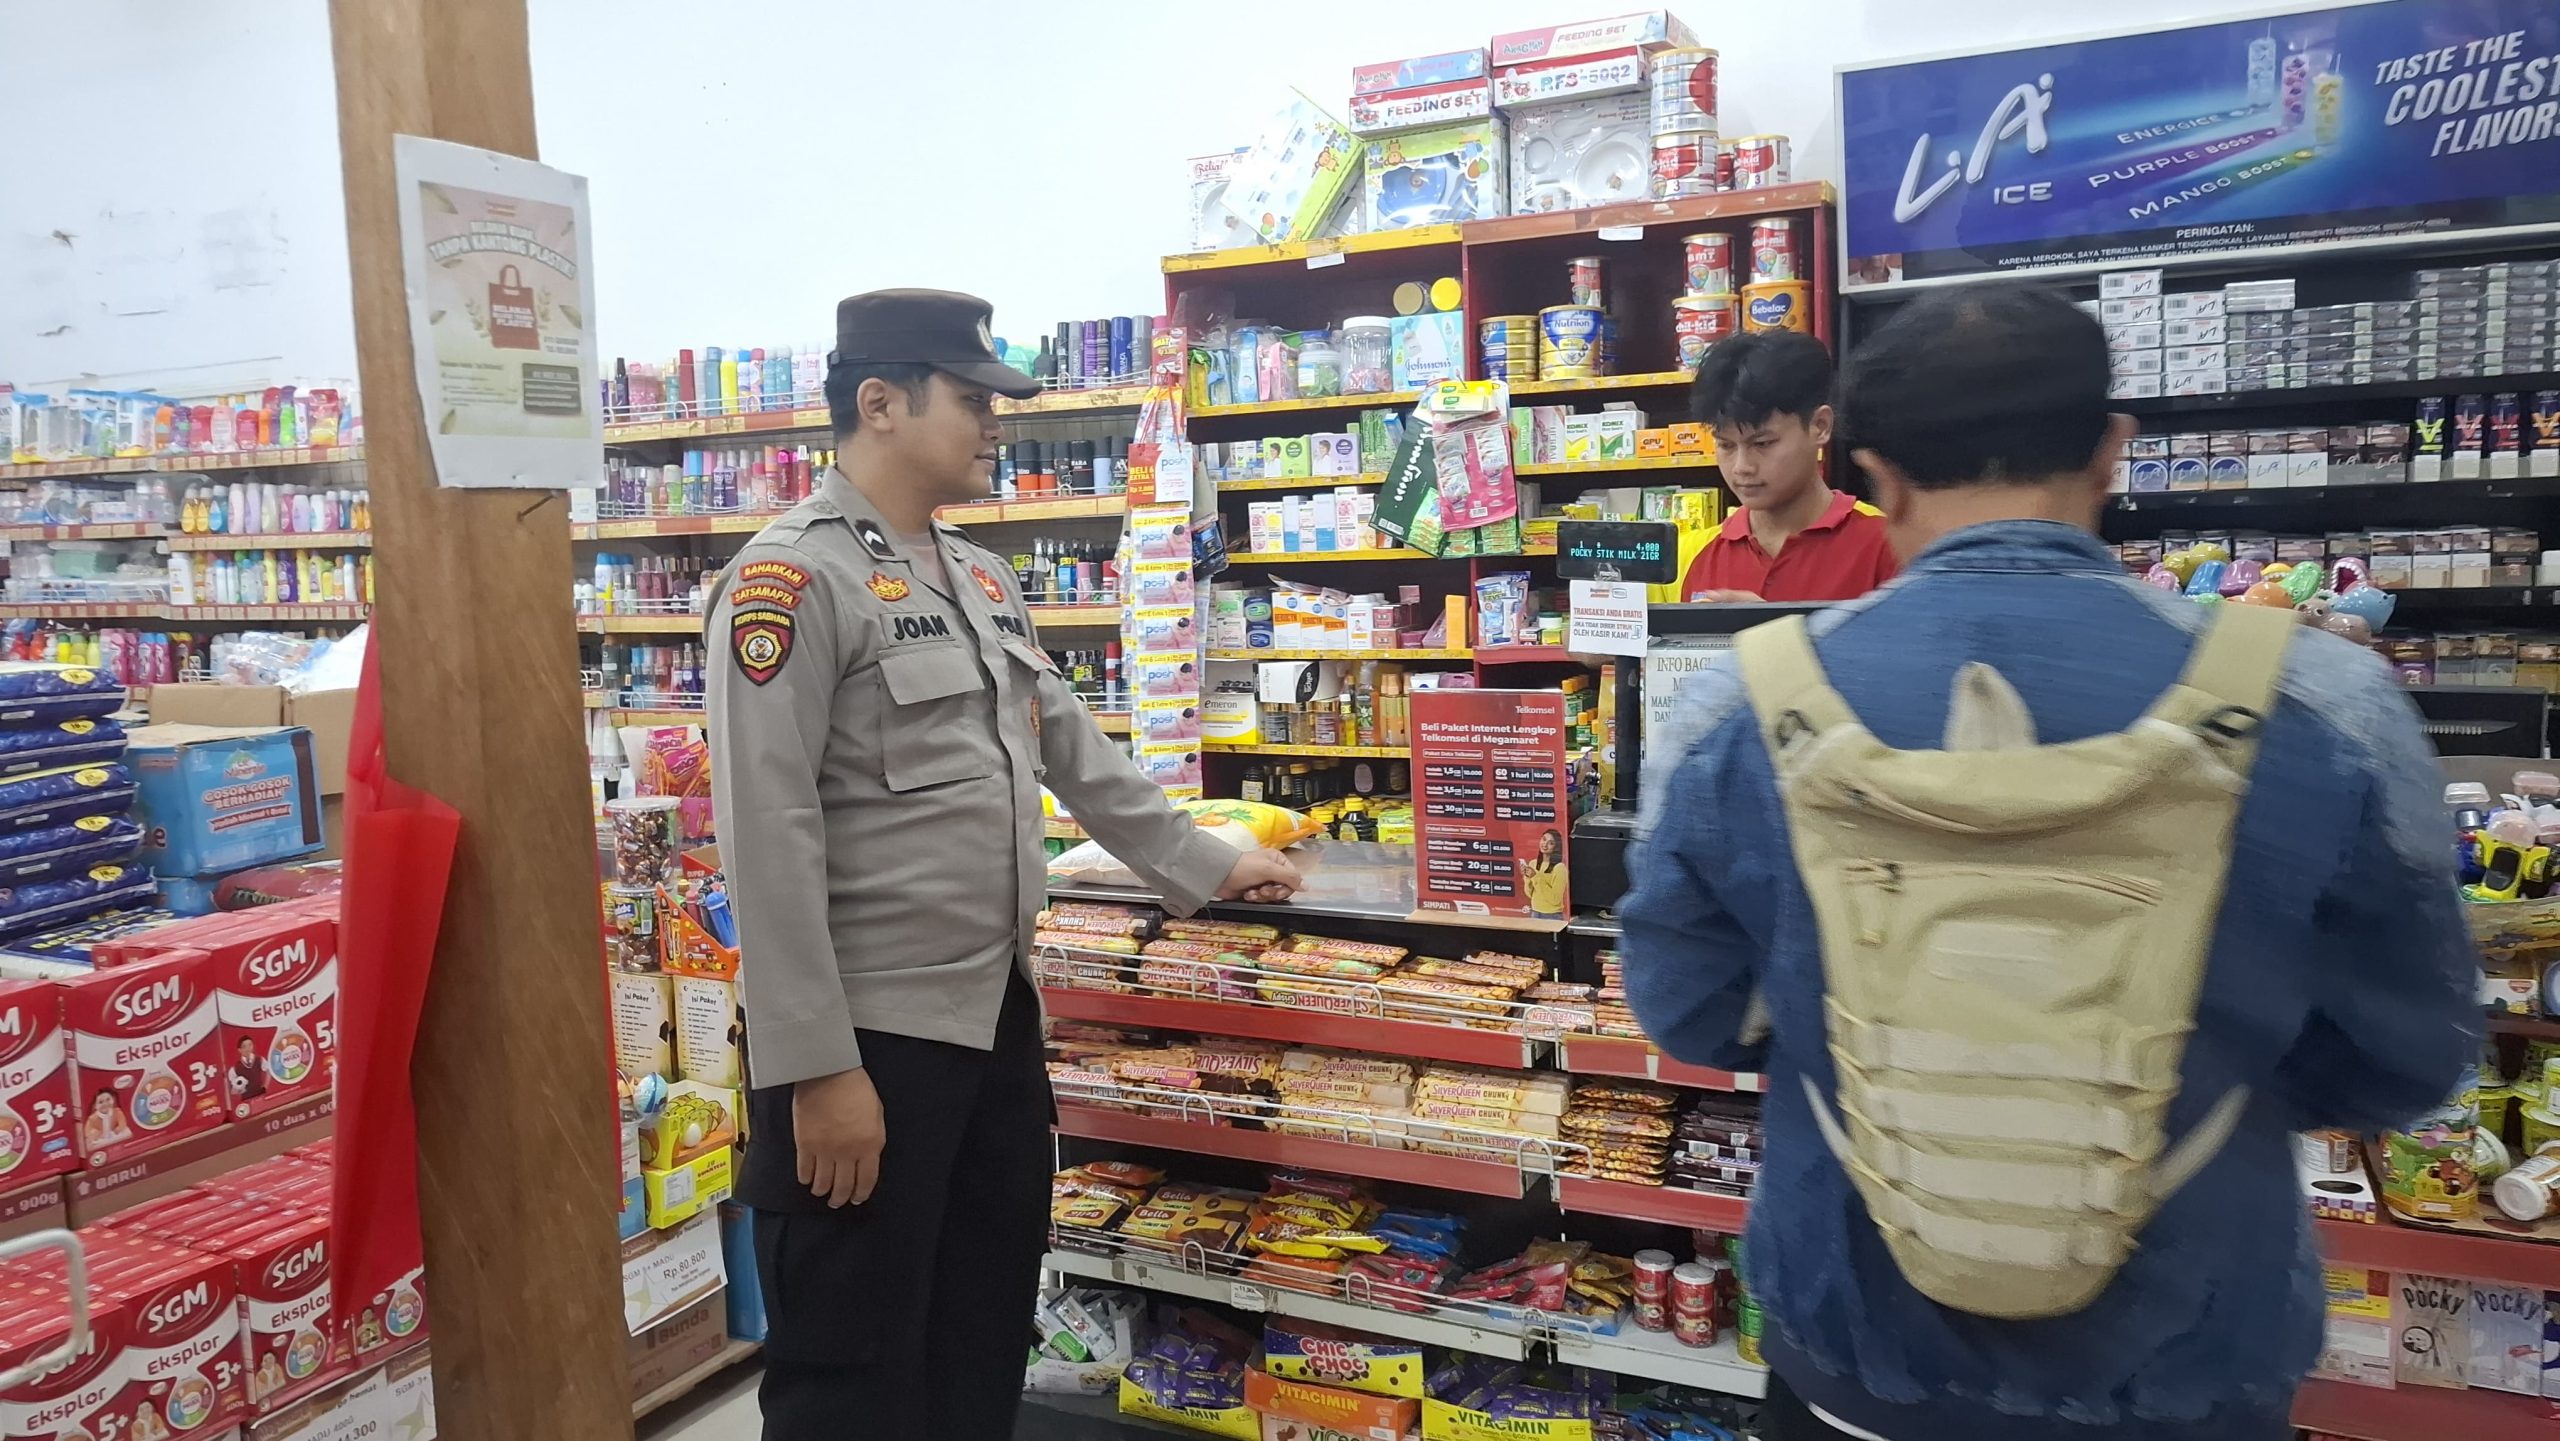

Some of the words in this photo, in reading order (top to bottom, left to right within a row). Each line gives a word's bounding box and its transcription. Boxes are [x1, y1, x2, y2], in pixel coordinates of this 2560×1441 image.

[2375, 45, 2458, 85] TASTE
[2464, 30, 2526, 67] THE
[2384, 53, 2560, 126] COOLEST
[1387, 99, 1450, 117] FEEDING
[1454, 94, 1481, 106] SET
[2116, 114, 2222, 144] ENERGICE
[2088, 150, 2200, 188] PURPLE
[2204, 135, 2256, 155] BOOST
[1992, 181, 2055, 206] ICE
[2128, 177, 2232, 219] MANGO
[2238, 157, 2287, 180] BOOST
[2175, 223, 2255, 239] PERINGATAN:
[1999, 257, 2031, 266] KARENA
[2077, 249, 2100, 259] SAYA
[2101, 246, 2140, 256] TERKENA
[2140, 243, 2176, 253] KANKER
[1751, 303, 1787, 315] Bebelac
[1642, 438, 1662, 447] GPU
[1677, 432, 1697, 441] GPU
[1142, 533, 1168, 547] posh
[1579, 540, 1584, 549] 1
[1570, 548, 1593, 558] POCKY
[1596, 549, 1615, 559] STIK
[1618, 550, 1637, 560] MILK
[1640, 551, 1660, 561] 21GR
[744, 563, 803, 584] BAHARKAM
[1144, 576, 1171, 593] posh
[735, 586, 794, 605] SATSAMAPTA
[1573, 608, 1606, 617] TRANSAKSI
[1606, 609, 1622, 618] ANDA
[1622, 610, 1643, 619] GRATIS
[894, 613, 950, 641] JOAN
[1146, 620, 1173, 636] posh
[1573, 629, 1590, 637] OLEH
[1590, 630, 1610, 638] KASIR
[1611, 631, 1629, 640] KAMI
[1148, 666, 1175, 683] posh
[1657, 657, 1683, 672] INFO
[1151, 711, 1177, 727] posh
[1515, 705, 1556, 715] Telkomsel
[1421, 723, 1440, 732] Beli
[1441, 724, 1469, 733] Paket
[1471, 724, 1511, 734] Internet
[1513, 726, 1557, 736] Lengkap
[1421, 734, 1470, 743] Telkomsel
[1471, 734, 1481, 743] di
[1483, 735, 1540, 746] Megamaret
[1153, 756, 1180, 774] posh
[1495, 768, 1508, 776] 60
[1515, 771, 1530, 779] hari
[214, 788, 283, 810] BERHADIAH
[1423, 901, 1451, 910] SIMPATI
[250, 938, 307, 986] SGM
[1077, 967, 1108, 979] CHUNKY
[114, 974, 180, 1026] SGM
[251, 991, 317, 1023] Eksplor
[115, 1031, 192, 1066] Eksplor
[189, 1060, 218, 1094] 3+
[1123, 1064, 1167, 1079] SILVERQUEEN
[1323, 1061, 1368, 1073] SILVERQUEEN
[1368, 1065, 1393, 1075] CHUNKY
[1289, 1079, 1333, 1092] SILVERQUEEN
[1334, 1084, 1358, 1094] CHUNKY
[1432, 1083, 1481, 1098] SILVERQUEEN
[1483, 1090, 1510, 1101] CHUNKY
[32, 1100, 67, 1134] 3+
[263, 1120, 280, 1133] 10
[283, 1112, 306, 1128] dus
[308, 1109, 317, 1118] x
[1428, 1103, 1477, 1116] SILVERQUEEN
[1478, 1109, 1505, 1121] CHUNKY
[95, 1163, 147, 1191] BARU!
[5, 1206, 14, 1216] x
[19, 1191, 59, 1212] 900g
[1161, 1190, 1192, 1201] Bella
[1138, 1209, 1170, 1219] Bella
[272, 1239, 324, 1289] SGM
[147, 1280, 208, 1334] SGM
[2401, 1287, 2466, 1315] POCKY
[2474, 1290, 2545, 1321] POCKY
[146, 1334, 220, 1376] Eksplor
[1301, 1337, 1348, 1358] CHIC
[1310, 1356, 1364, 1372] CHOC
[214, 1361, 242, 1391] 3+
[1277, 1382, 1361, 1412] VITACIMIN
[26, 1386, 107, 1432] Eksplor
[98, 1412, 129, 1441] 5+
